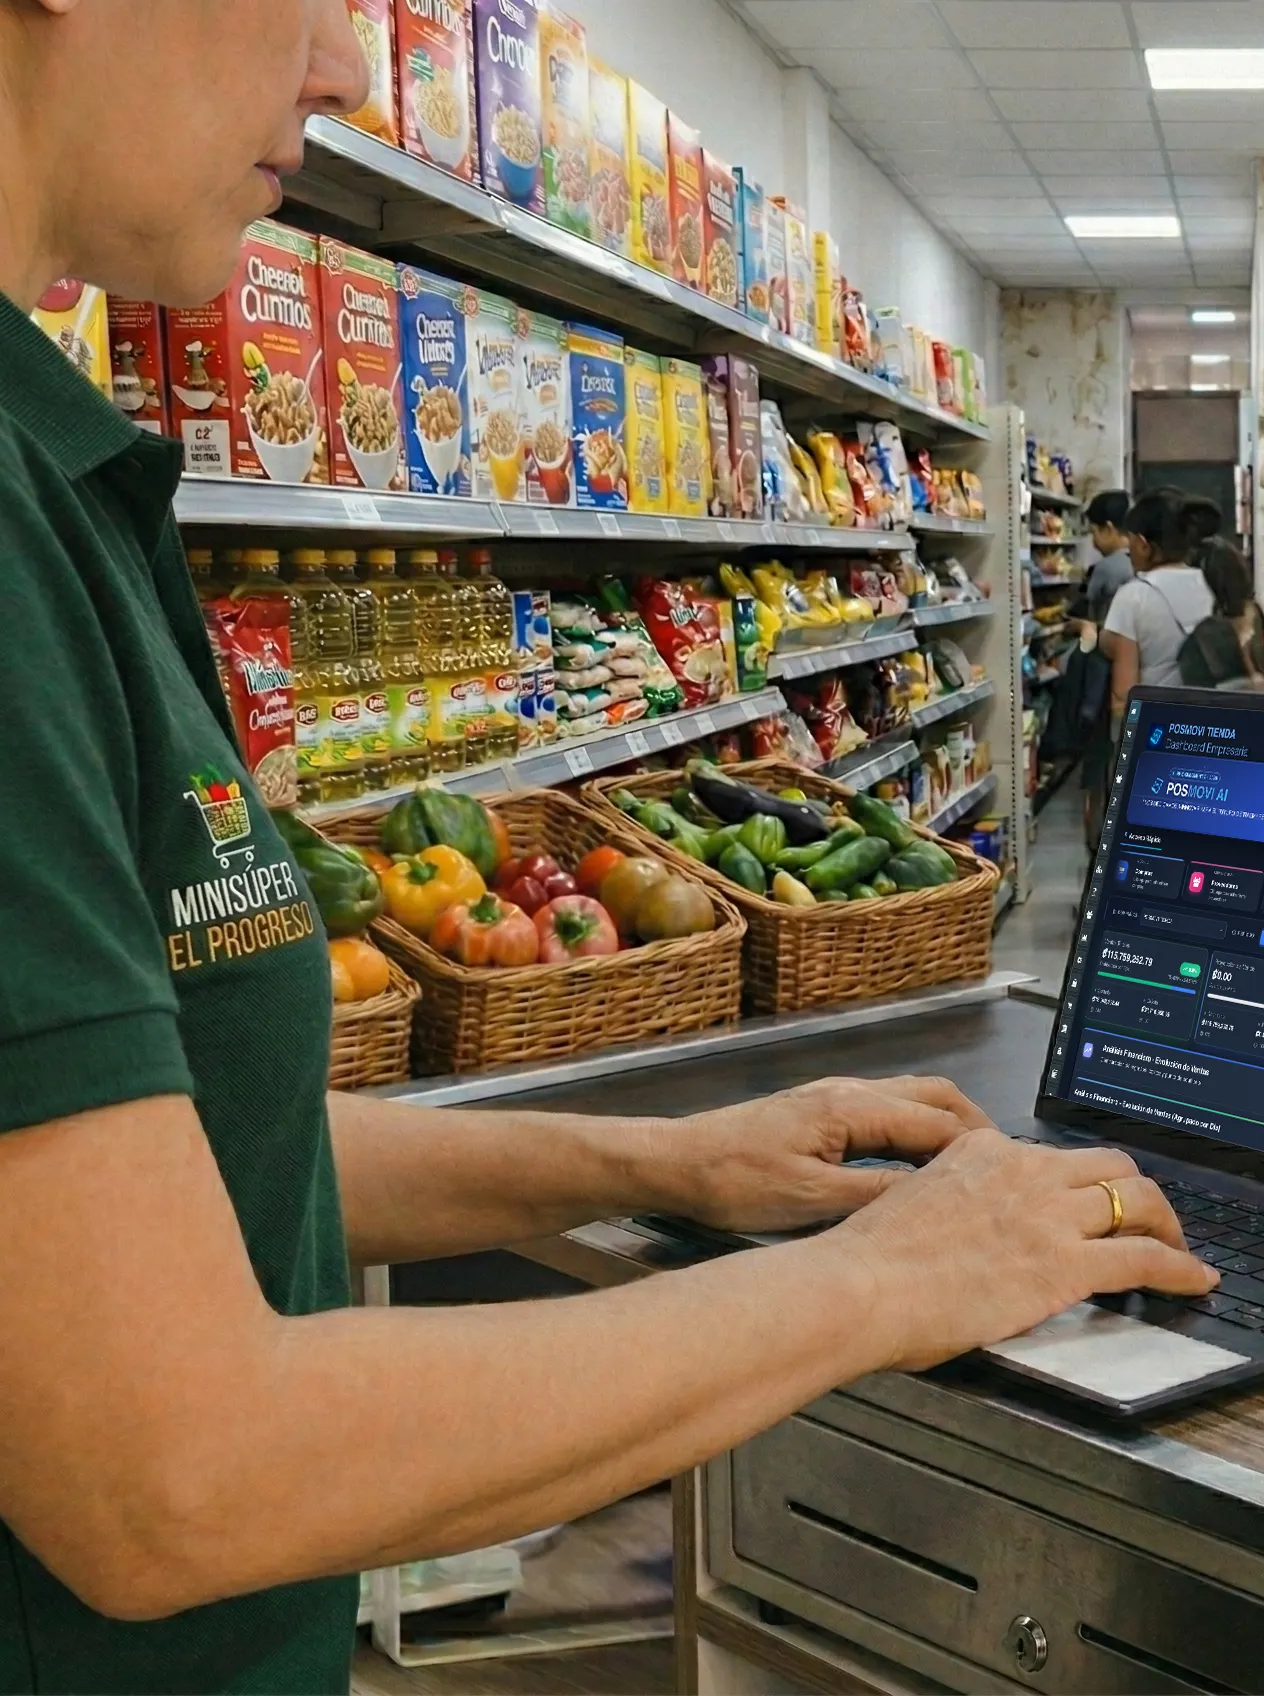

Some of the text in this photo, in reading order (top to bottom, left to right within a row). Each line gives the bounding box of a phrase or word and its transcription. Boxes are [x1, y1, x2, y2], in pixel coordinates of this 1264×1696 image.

[1168, 723, 1237, 740] POSMOVI TIENDA
[1166, 782, 1215, 800] POSMOVI
[171, 861, 298, 928] MINISÚPER
[168, 901, 314, 971] EL PROGRESO
